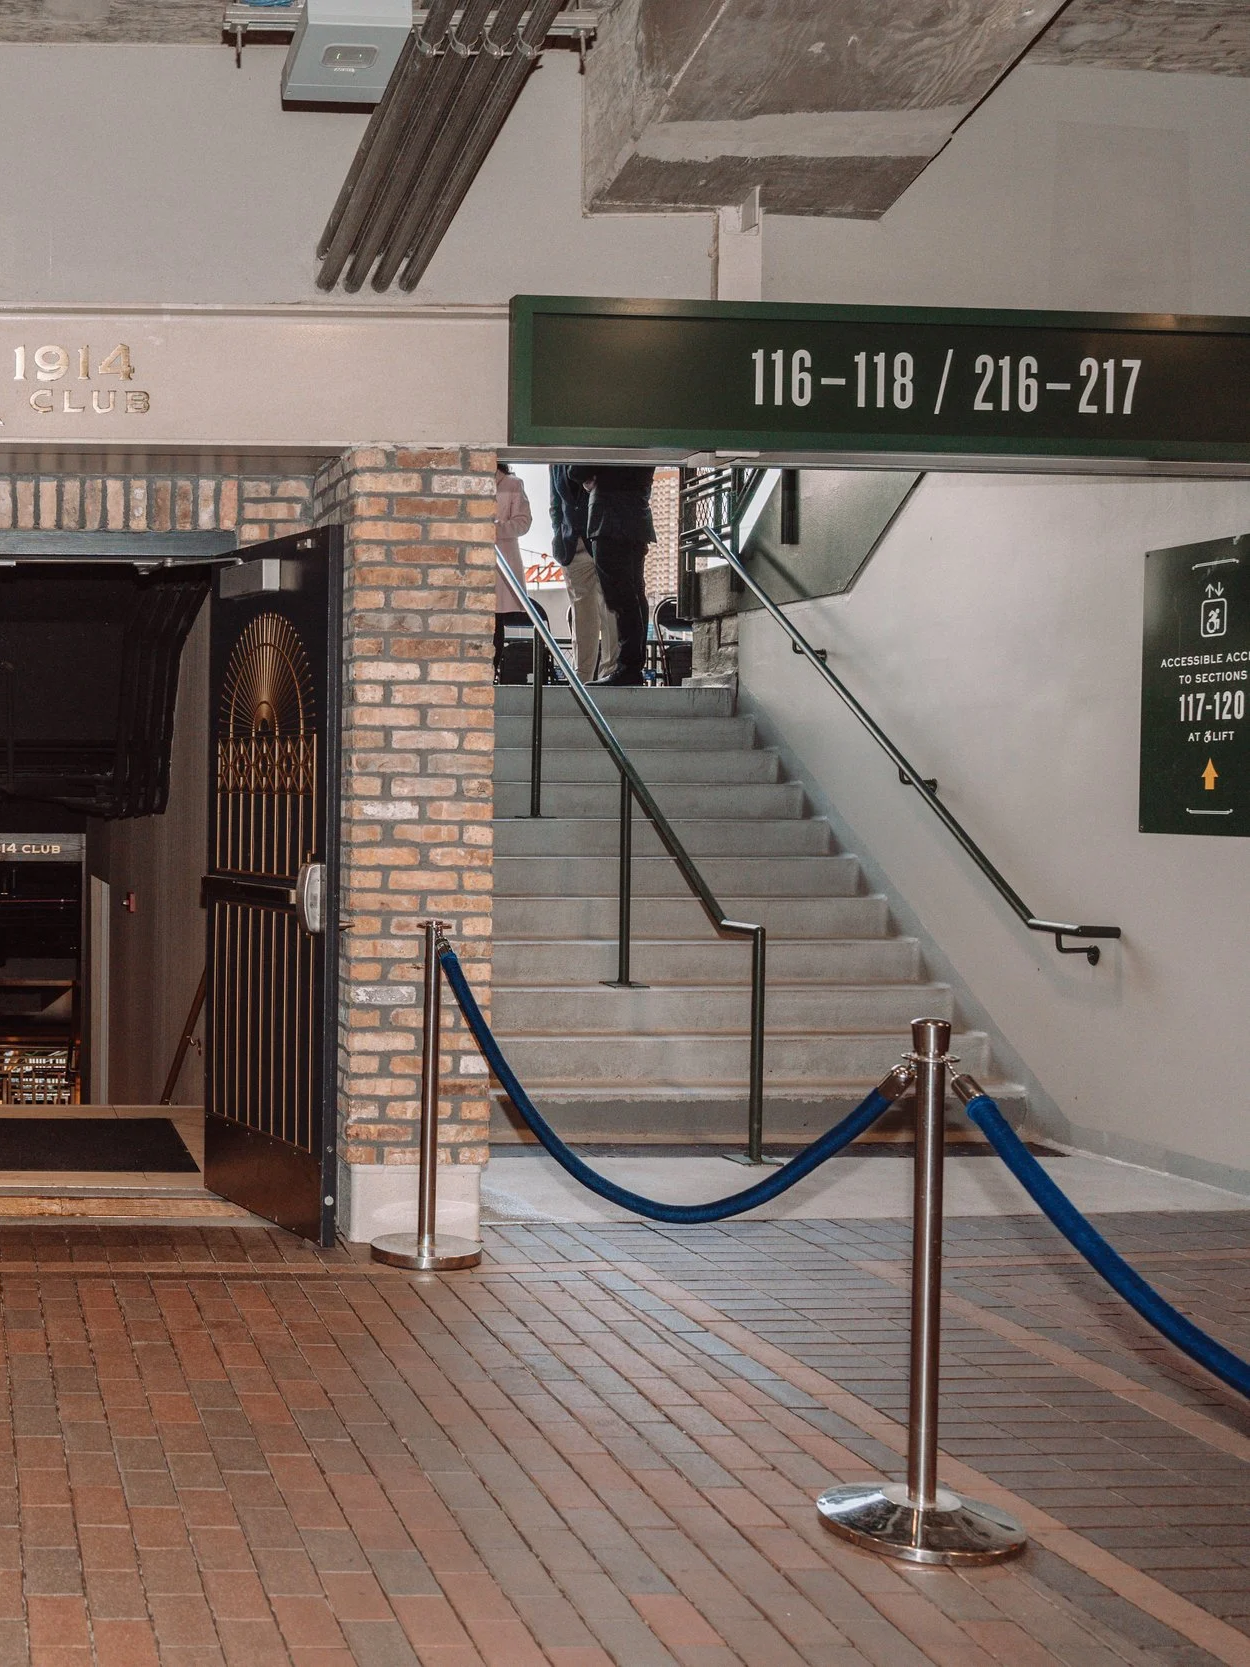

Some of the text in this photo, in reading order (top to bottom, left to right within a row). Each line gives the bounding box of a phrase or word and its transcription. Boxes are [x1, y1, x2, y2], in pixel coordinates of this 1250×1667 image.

[14, 343, 136, 382] 1914
[29, 388, 151, 414] CLUB
[1160, 651, 1250, 669] ACCESSIBLE ACC
[1178, 670, 1248, 685] TO SECTIONS
[1179, 690, 1245, 722] 117-120
[1187, 731, 1235, 742] AT LIFT
[20, 844, 62, 854] CLUB
